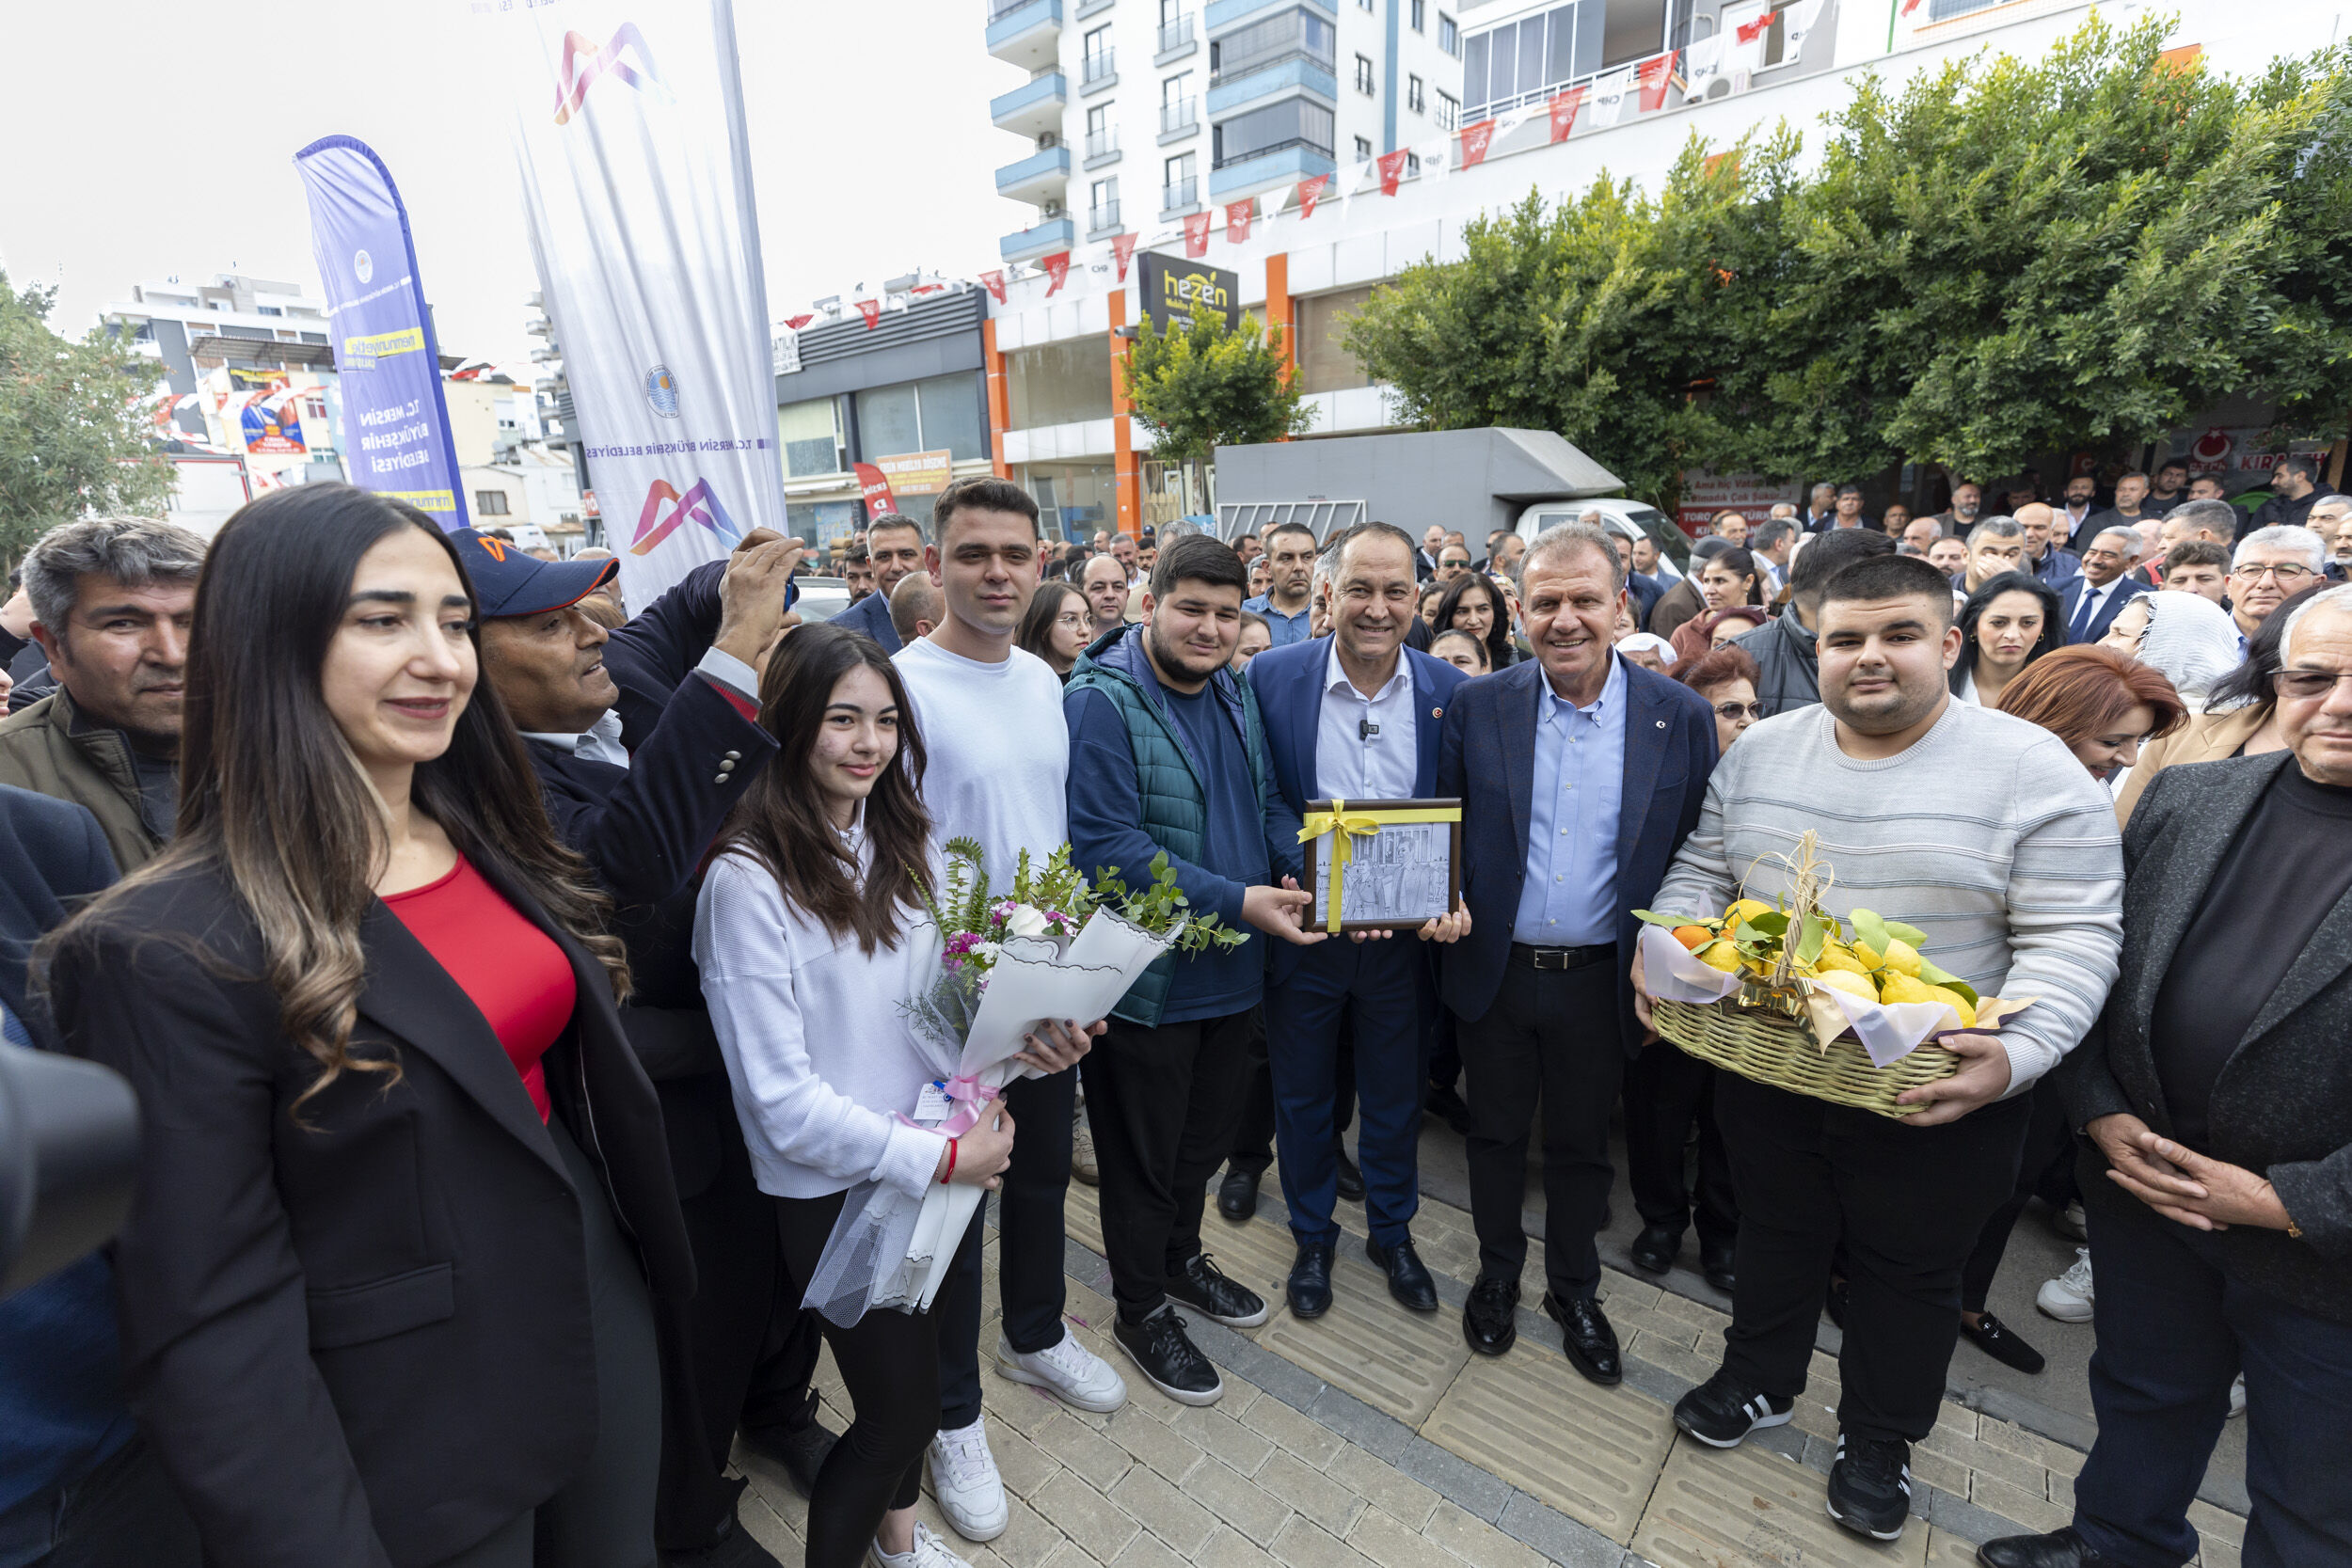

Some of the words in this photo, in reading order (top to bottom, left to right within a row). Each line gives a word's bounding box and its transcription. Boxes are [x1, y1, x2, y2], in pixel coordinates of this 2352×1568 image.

[1164, 269, 1227, 307] hezen
[773, 335, 797, 352] ATILIK
[1684, 512, 1712, 522] TORO
